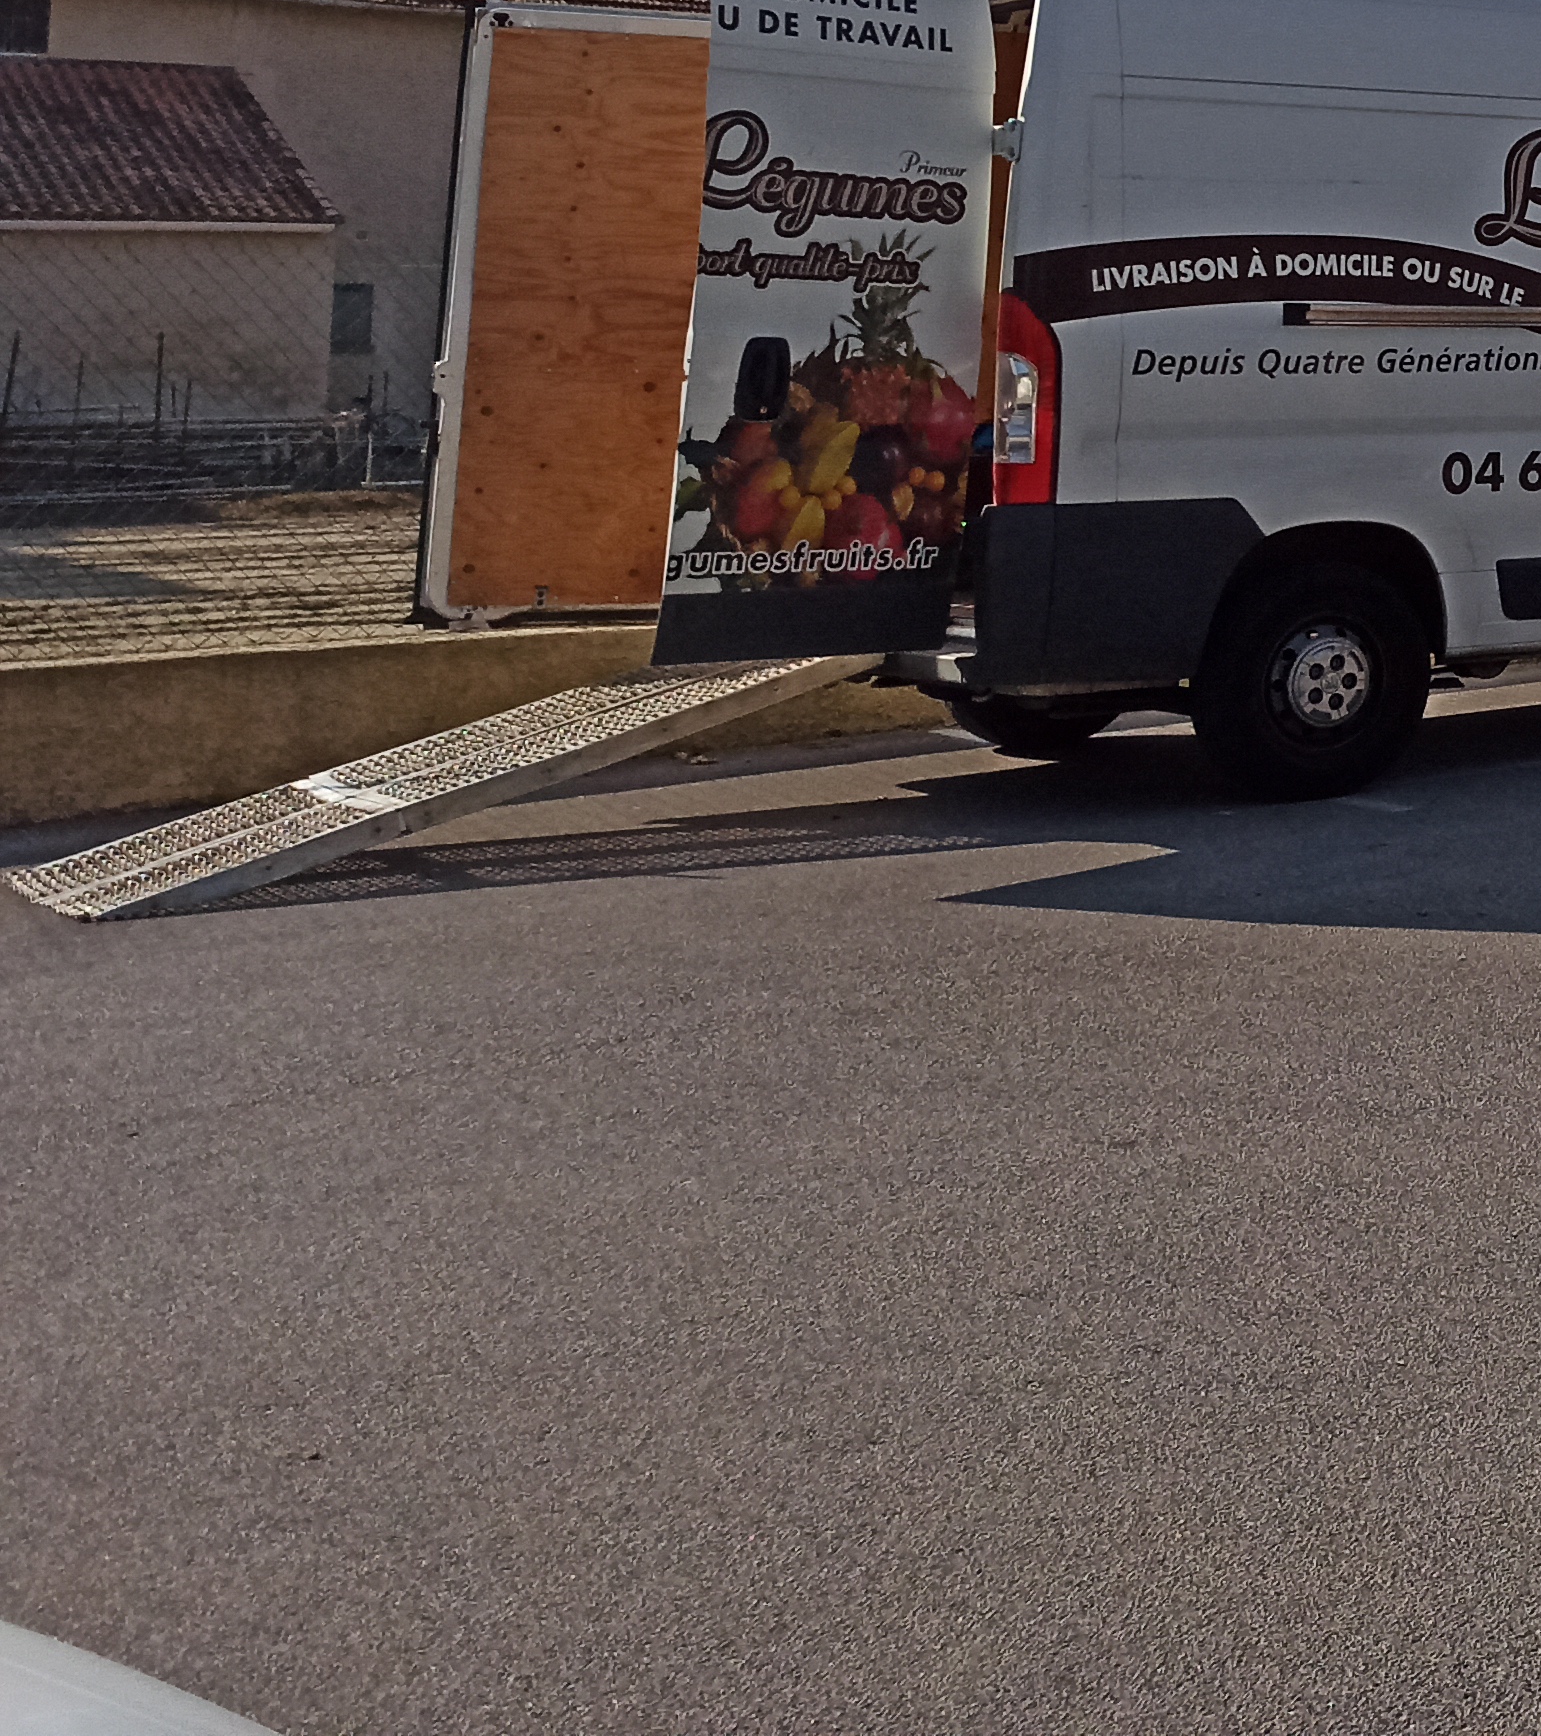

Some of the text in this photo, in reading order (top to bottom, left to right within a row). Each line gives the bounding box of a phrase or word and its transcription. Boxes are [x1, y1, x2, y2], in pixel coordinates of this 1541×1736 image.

[759, 9, 799, 37] DE
[816, 15, 953, 53] TRAVAIL
[702, 109, 968, 238] Légumes
[899, 150, 967, 178] Primeur
[1091, 247, 1525, 306] LIVRAISON À DOMICILE OU SUR LE
[1132, 348, 1245, 382] Depuis
[1258, 349, 1364, 379] Quatre
[1442, 451, 1505, 495] 04
